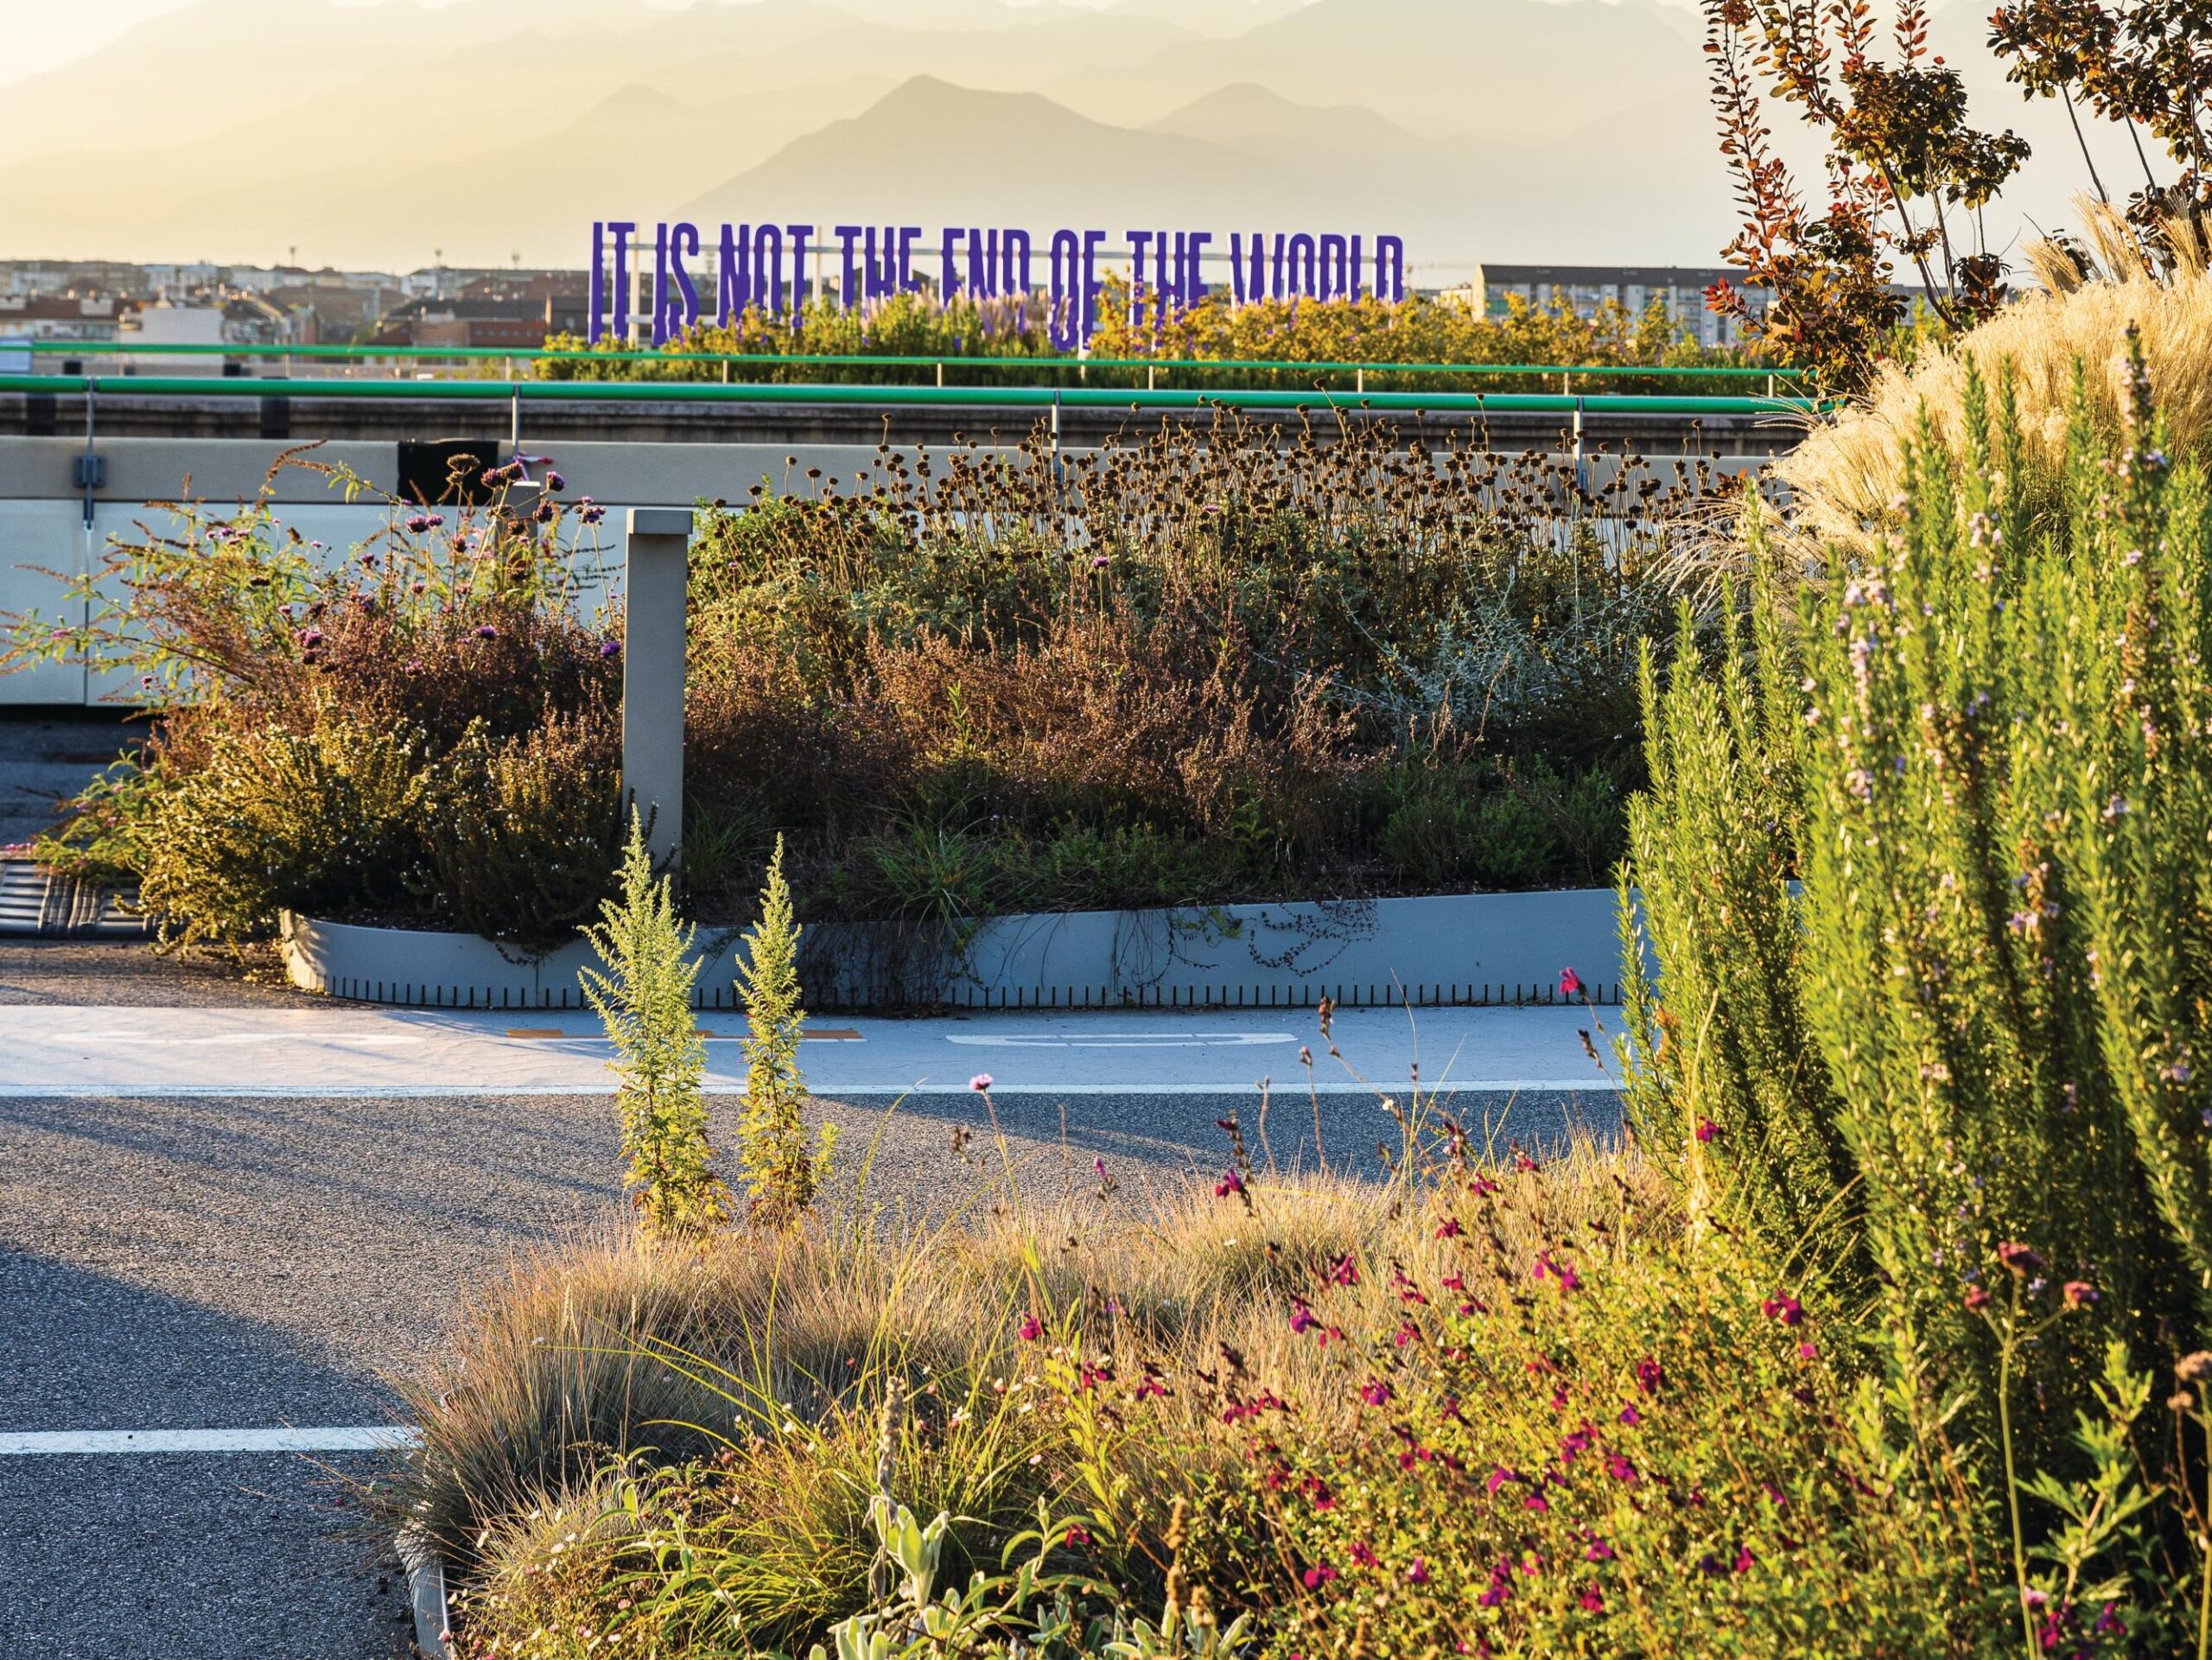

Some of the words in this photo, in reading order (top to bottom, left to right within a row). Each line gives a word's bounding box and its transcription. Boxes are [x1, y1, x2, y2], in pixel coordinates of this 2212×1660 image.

[590, 222, 633, 345] IT
[652, 223, 699, 346] IS
[718, 224, 814, 335] NOT
[835, 226, 921, 318] THE
[941, 228, 1030, 318] END
[1050, 230, 1106, 351] OF
[1126, 231, 1211, 340] THE
